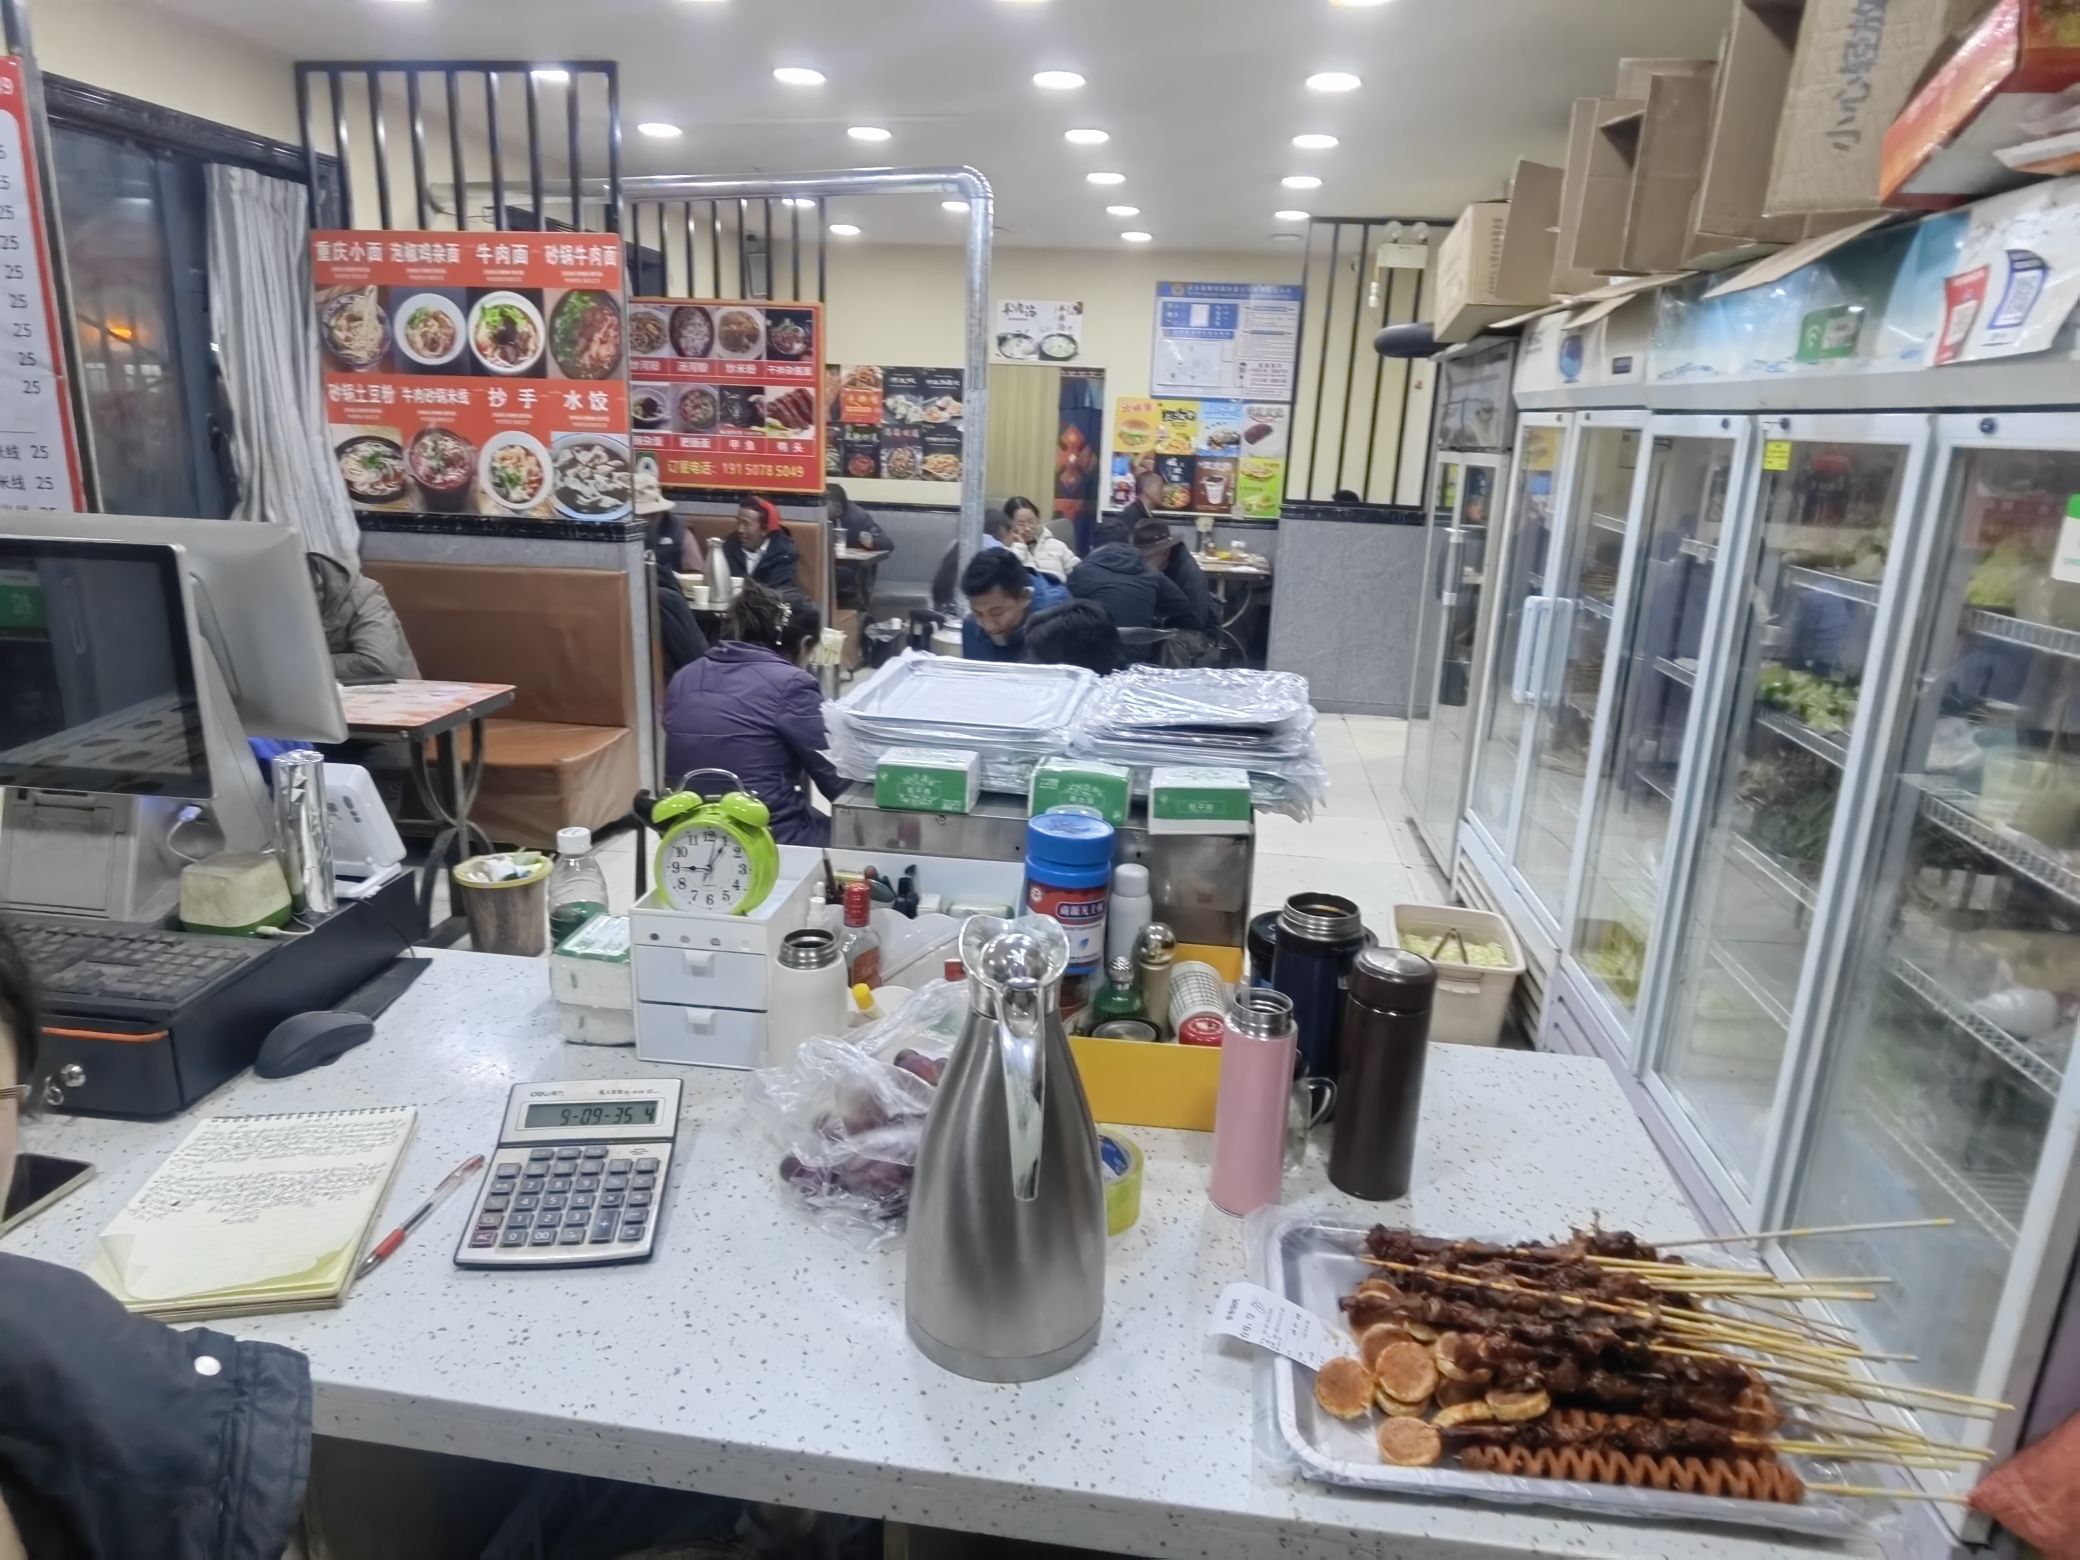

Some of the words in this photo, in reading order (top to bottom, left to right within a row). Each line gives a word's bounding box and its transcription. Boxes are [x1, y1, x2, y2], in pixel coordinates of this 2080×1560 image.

[0, 235, 20, 250] 25
[314, 240, 384, 263] 重庆小面
[475, 243, 529, 265] 牛肉面
[544, 244, 618, 267] 砂锅牛肉面
[5, 264, 24, 280] 25
[9, 293, 28, 309] 25
[13, 322, 32, 338] 25
[18, 352, 37, 367] 25
[22, 380, 42, 395] 25
[327, 383, 396, 404] 砂锅土豆粉
[562, 389, 609, 412] 水饺
[30, 444, 49, 460] 25
[722, 462, 742, 475] 191
[35, 476, 54, 491] 25
[688, 834, 699, 846] 11
[703, 830, 717, 842] 12
[675, 846, 689, 858] 10
[733, 846, 742, 859] 2
[671, 861, 680, 874] 9
[738, 863, 748, 875] 3
[677, 877, 687, 890] 8
[732, 879, 741, 891] 4
[690, 889, 699, 902] 7
[705, 893, 715, 906] 6
[722, 889, 731, 902] 5
[534, 1231, 549, 1240] 00
